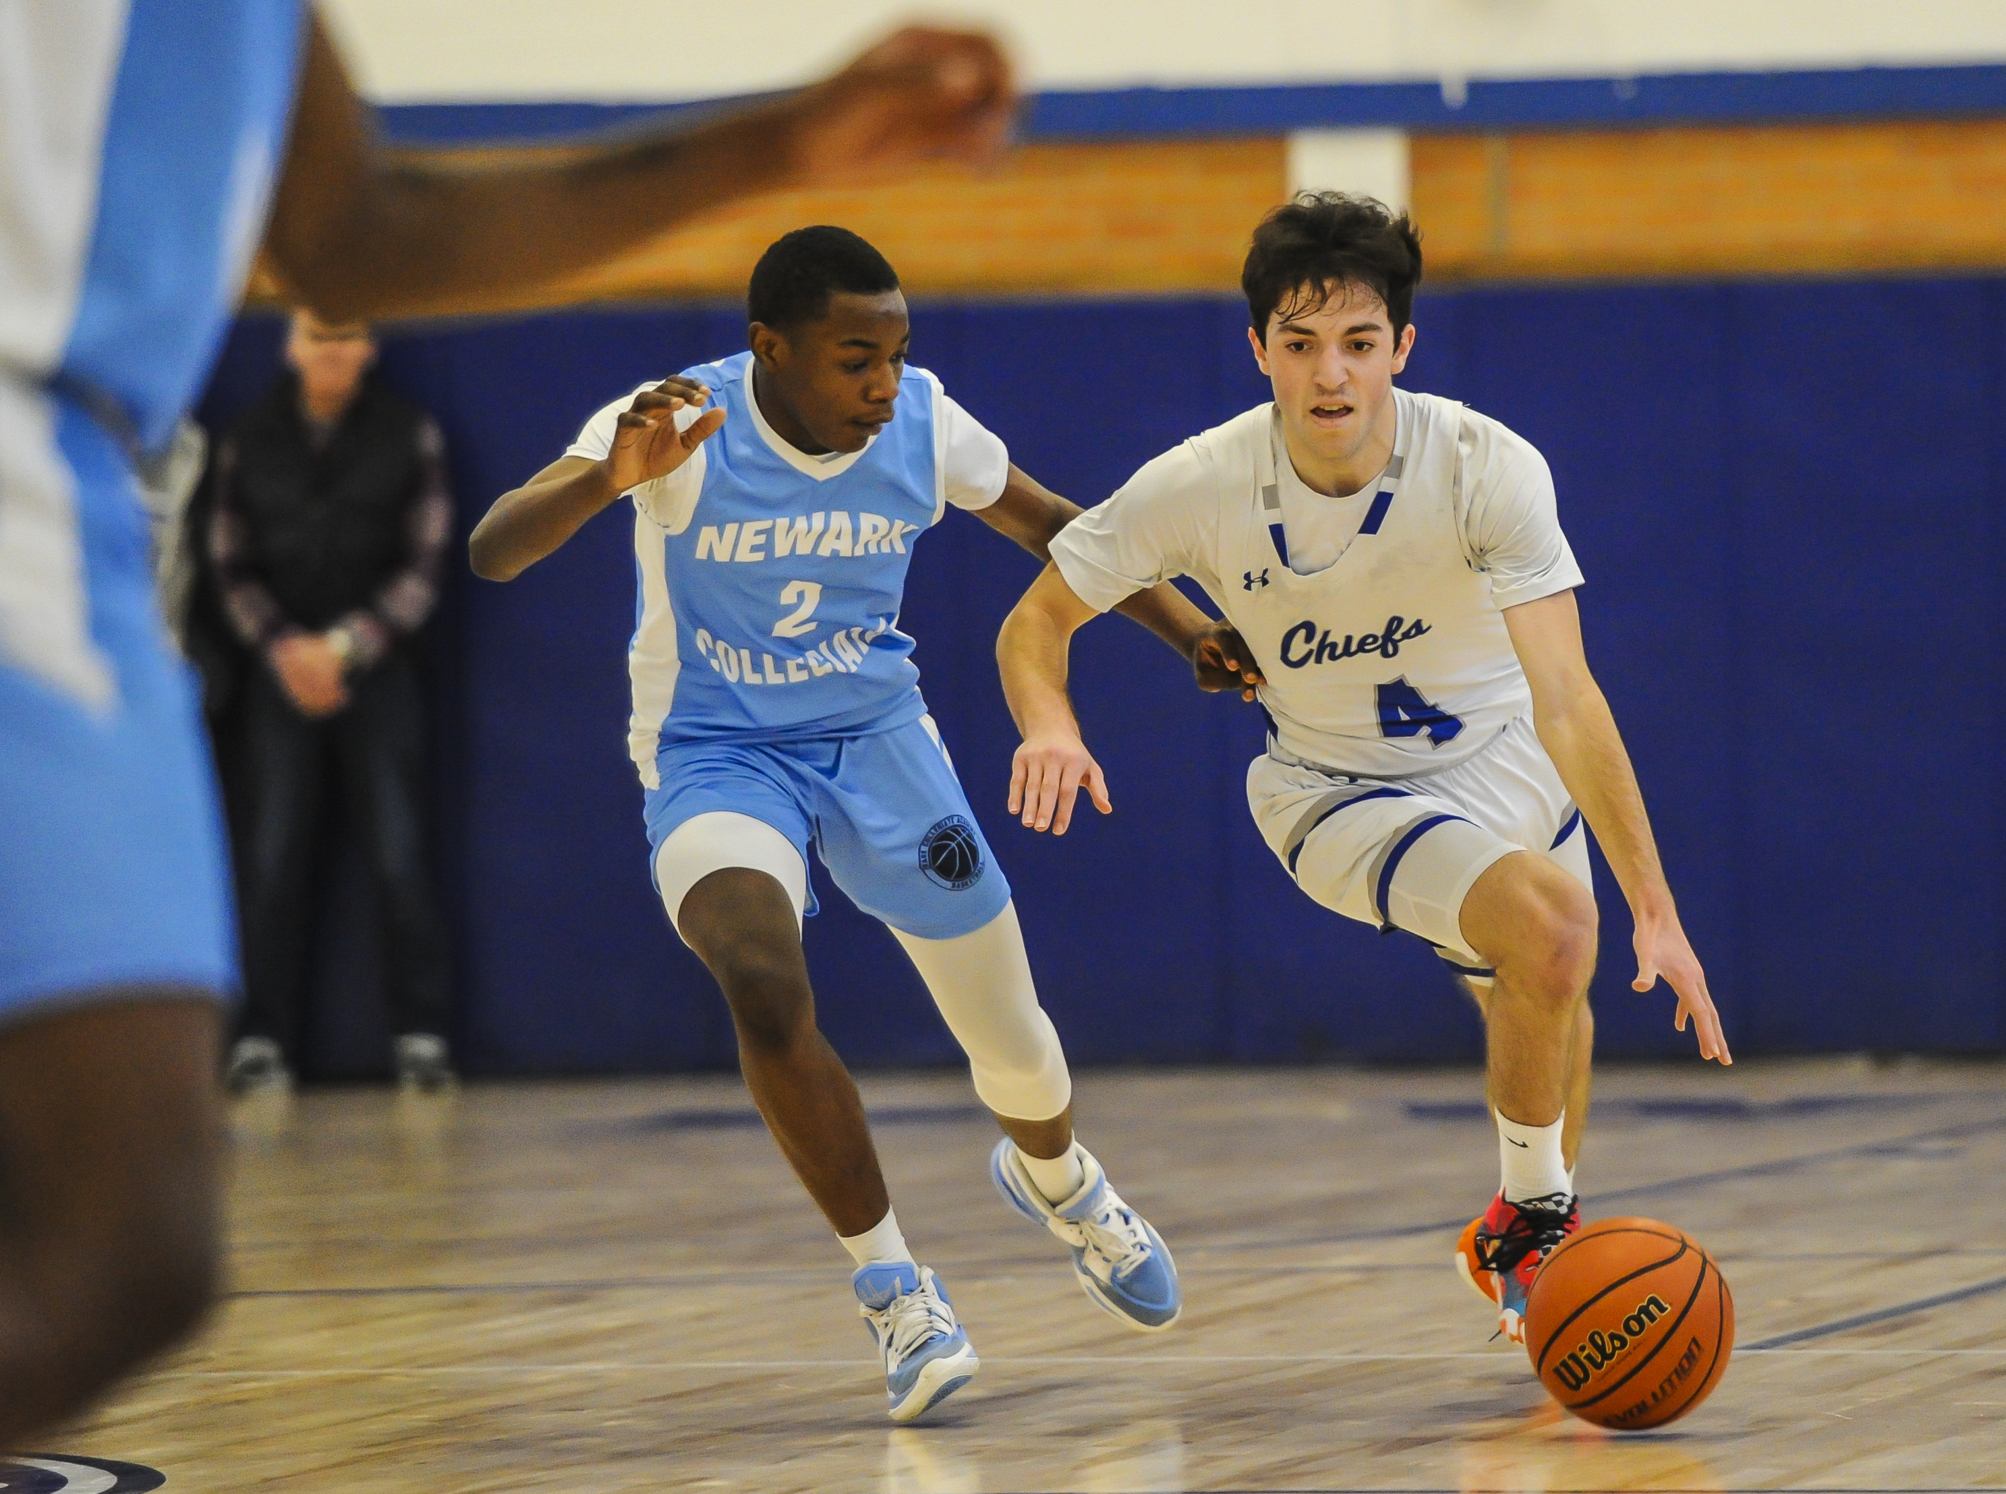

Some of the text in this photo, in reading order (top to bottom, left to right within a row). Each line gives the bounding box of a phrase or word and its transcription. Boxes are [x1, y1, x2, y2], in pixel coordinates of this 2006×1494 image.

[695, 511, 918, 562] NEWARK
[772, 580, 822, 638] 2
[1280, 615, 1432, 669] Chiefs
[1373, 673, 1467, 750] 4
[1552, 1293, 1672, 1392] Wilson
